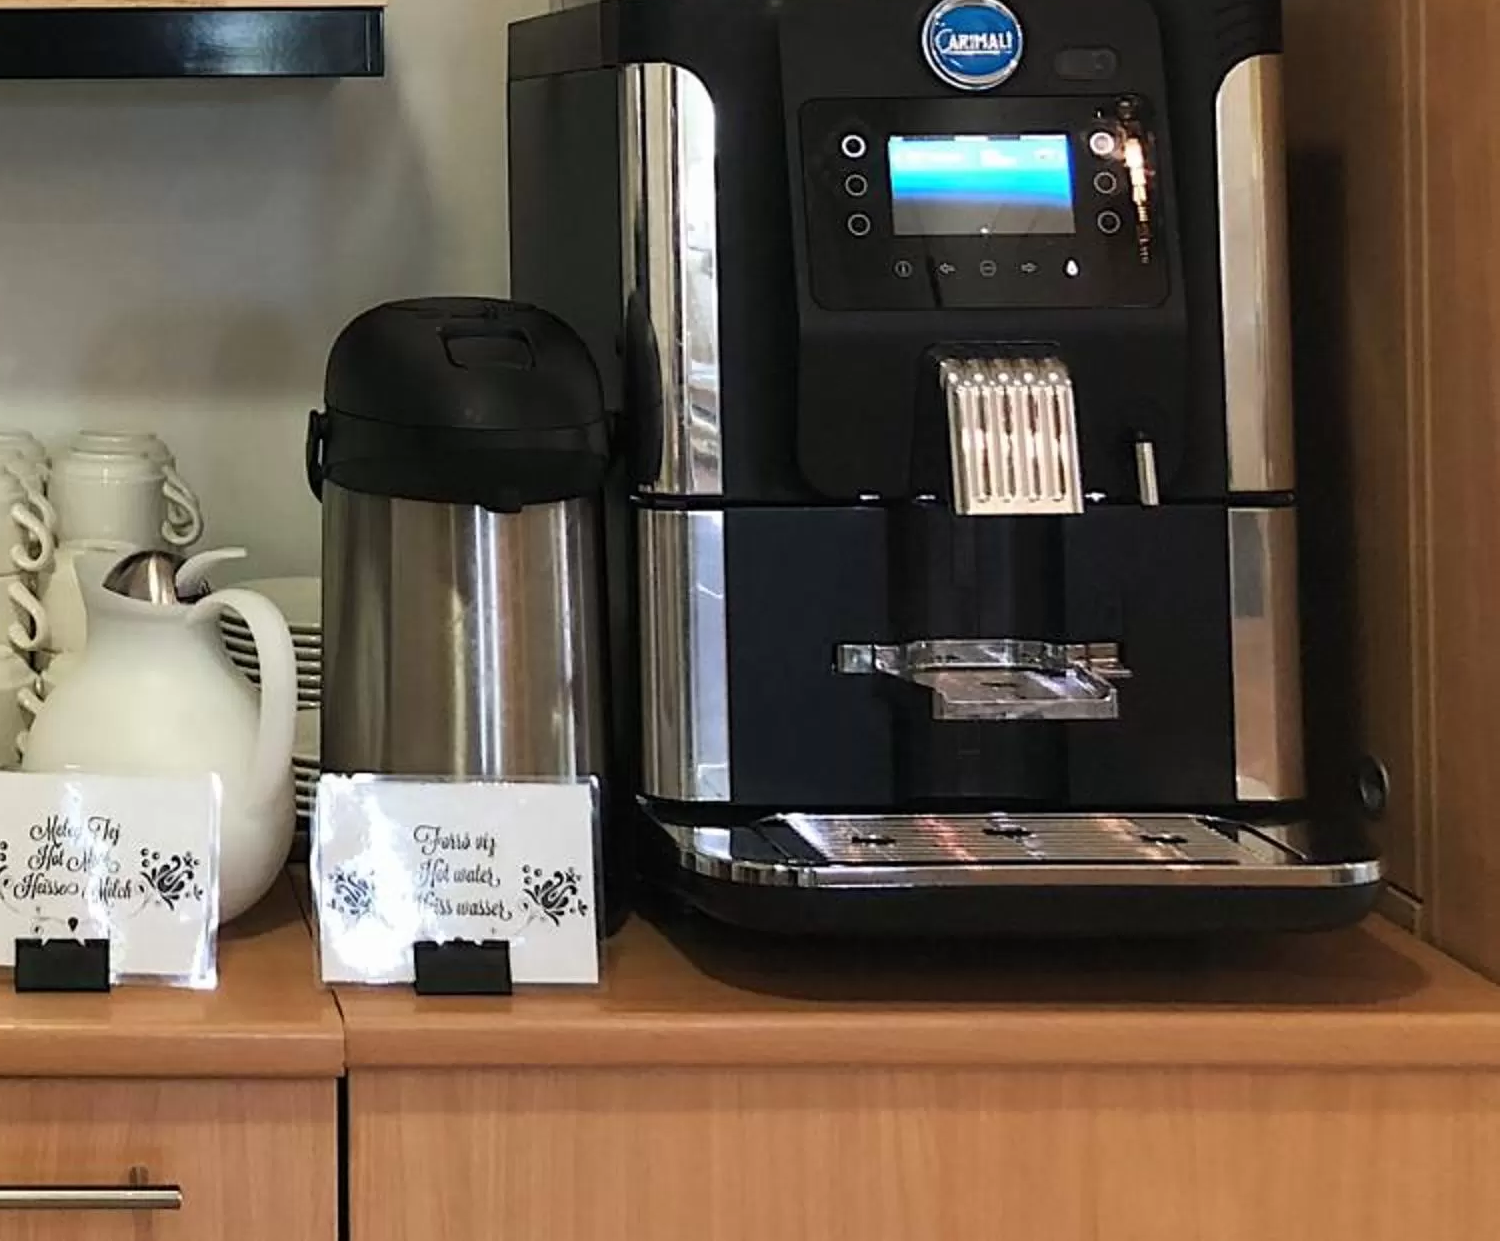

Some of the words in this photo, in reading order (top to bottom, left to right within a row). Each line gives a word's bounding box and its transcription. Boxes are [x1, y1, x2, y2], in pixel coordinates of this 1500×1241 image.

[934, 28, 1013, 54] CARIMALI
[28, 844, 64, 872] Hot
[414, 857, 451, 889] Hot
[453, 862, 501, 889] water
[455, 898, 513, 922] wasser
